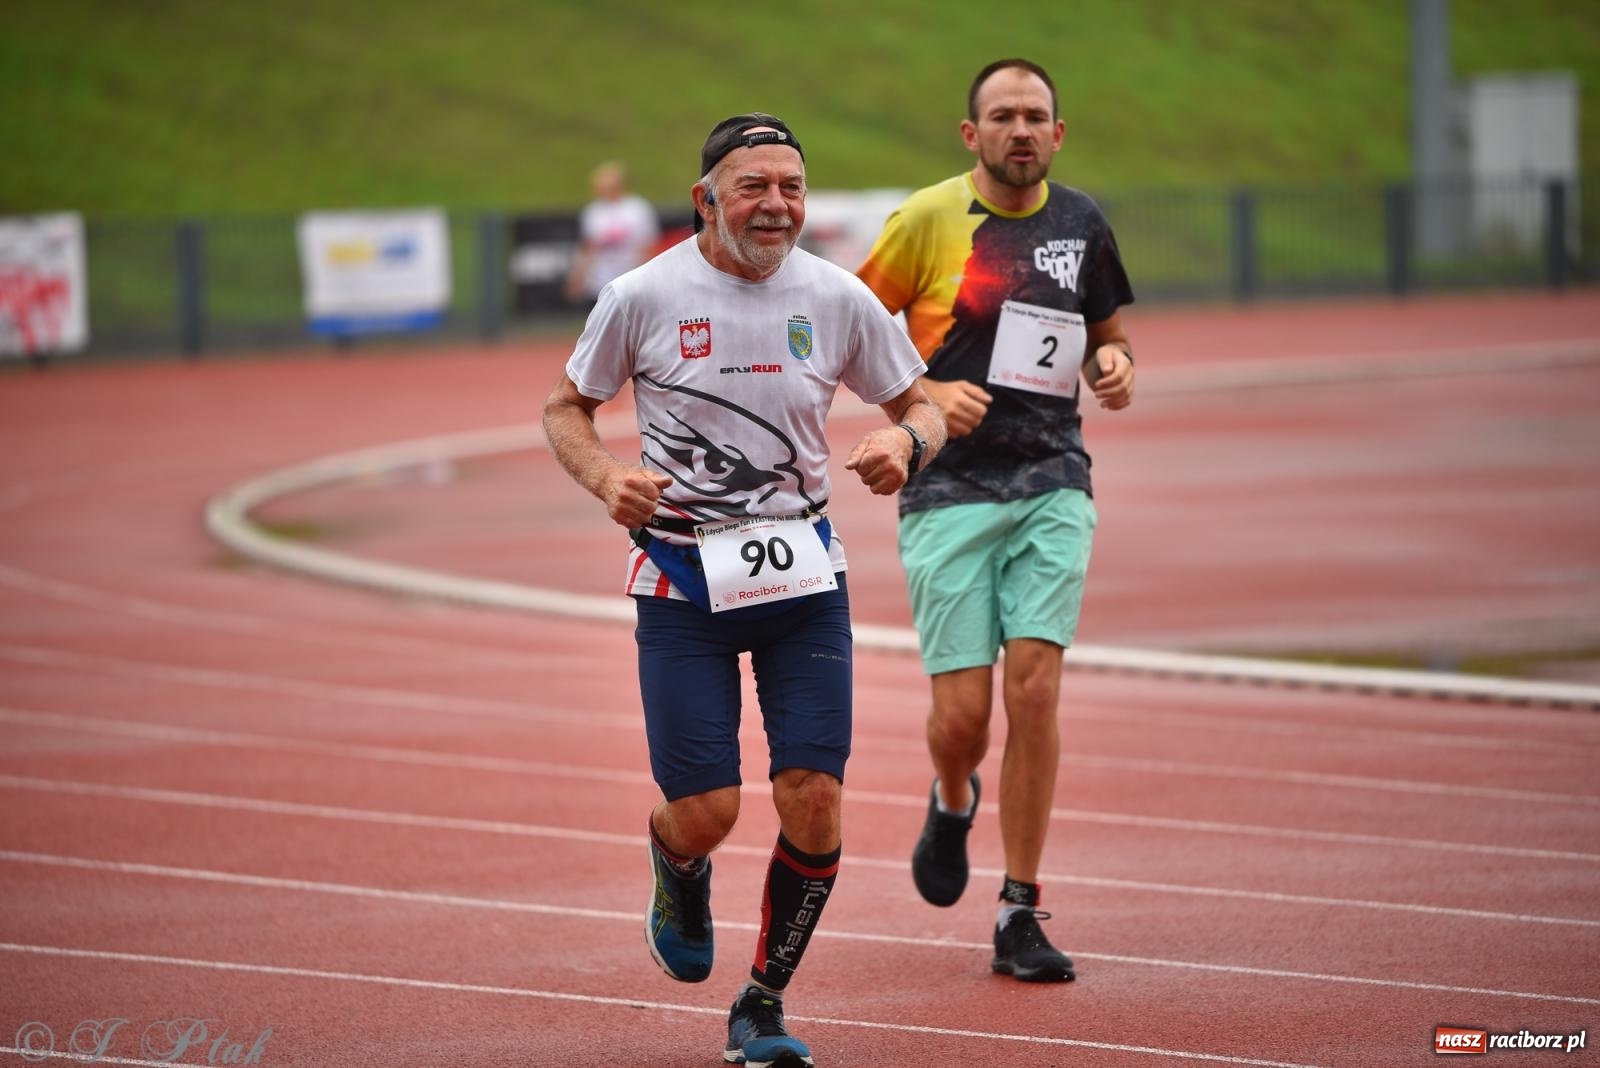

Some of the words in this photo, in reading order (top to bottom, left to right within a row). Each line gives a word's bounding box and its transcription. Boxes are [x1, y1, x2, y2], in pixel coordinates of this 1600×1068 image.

[1034, 246, 1084, 293] GÓRY
[679, 317, 711, 325] POLSKA
[1037, 335, 1058, 369] 2
[706, 526, 724, 536] Edycja
[724, 522, 740, 531] Biegu
[741, 536, 794, 577] 90
[738, 583, 788, 600] Racibórz
[800, 576, 823, 589] OSiR
